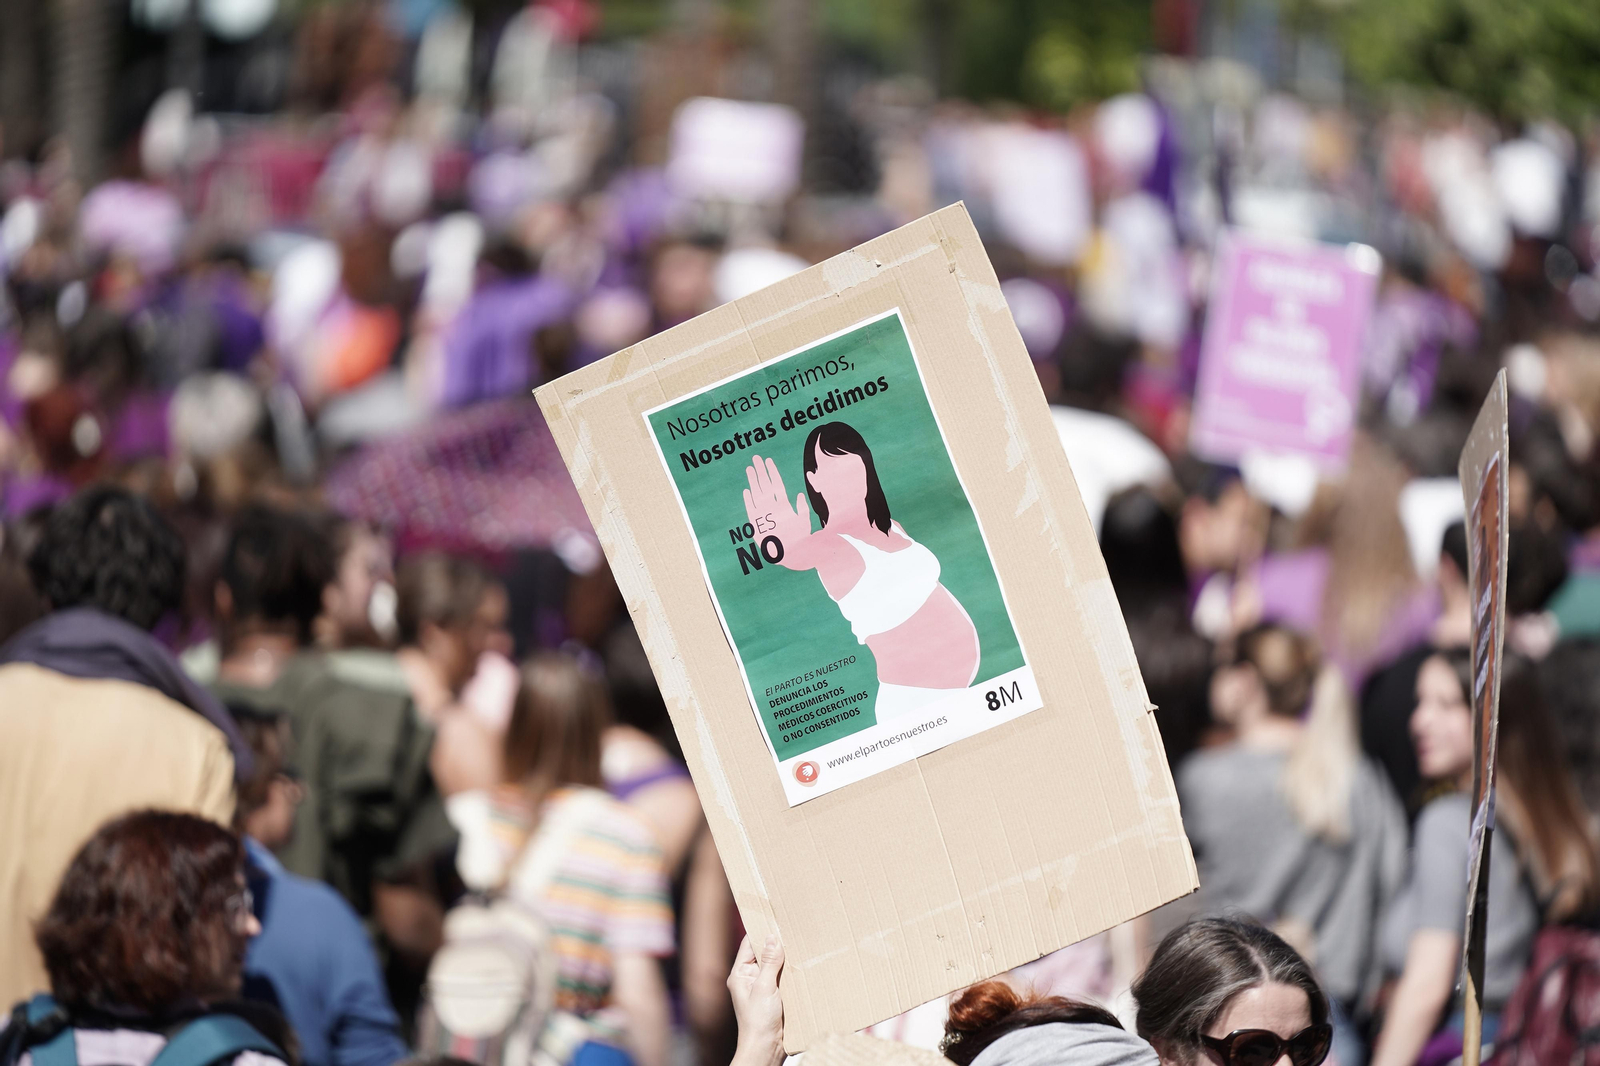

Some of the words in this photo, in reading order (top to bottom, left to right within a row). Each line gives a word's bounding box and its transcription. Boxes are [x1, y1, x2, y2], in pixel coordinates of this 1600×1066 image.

[666, 391, 761, 440] Nosotras
[765, 355, 855, 406] parimos,
[679, 421, 777, 472] Nosotras
[780, 376, 889, 431] decidimos
[729, 522, 755, 545] NO
[755, 513, 776, 534] ES
[736, 535, 784, 576] NO
[774, 676, 803, 693] PARTO
[804, 671, 814, 681] ES
[815, 655, 856, 677] NUESTRO
[769, 686, 811, 708] DENUNCIA
[812, 679, 828, 692] LOS
[773, 686, 845, 720] PROCEDIMIENTOS
[778, 711, 815, 731] MÉDICOS
[815, 690, 868, 717] COERCITIVOS
[985, 681, 1023, 711] 8M
[783, 735, 790, 743] O
[790, 729, 803, 740] NO
[804, 707, 860, 735] CONSENTIDOS
[827, 714, 948, 769] www.elpartoesnuestro.es
